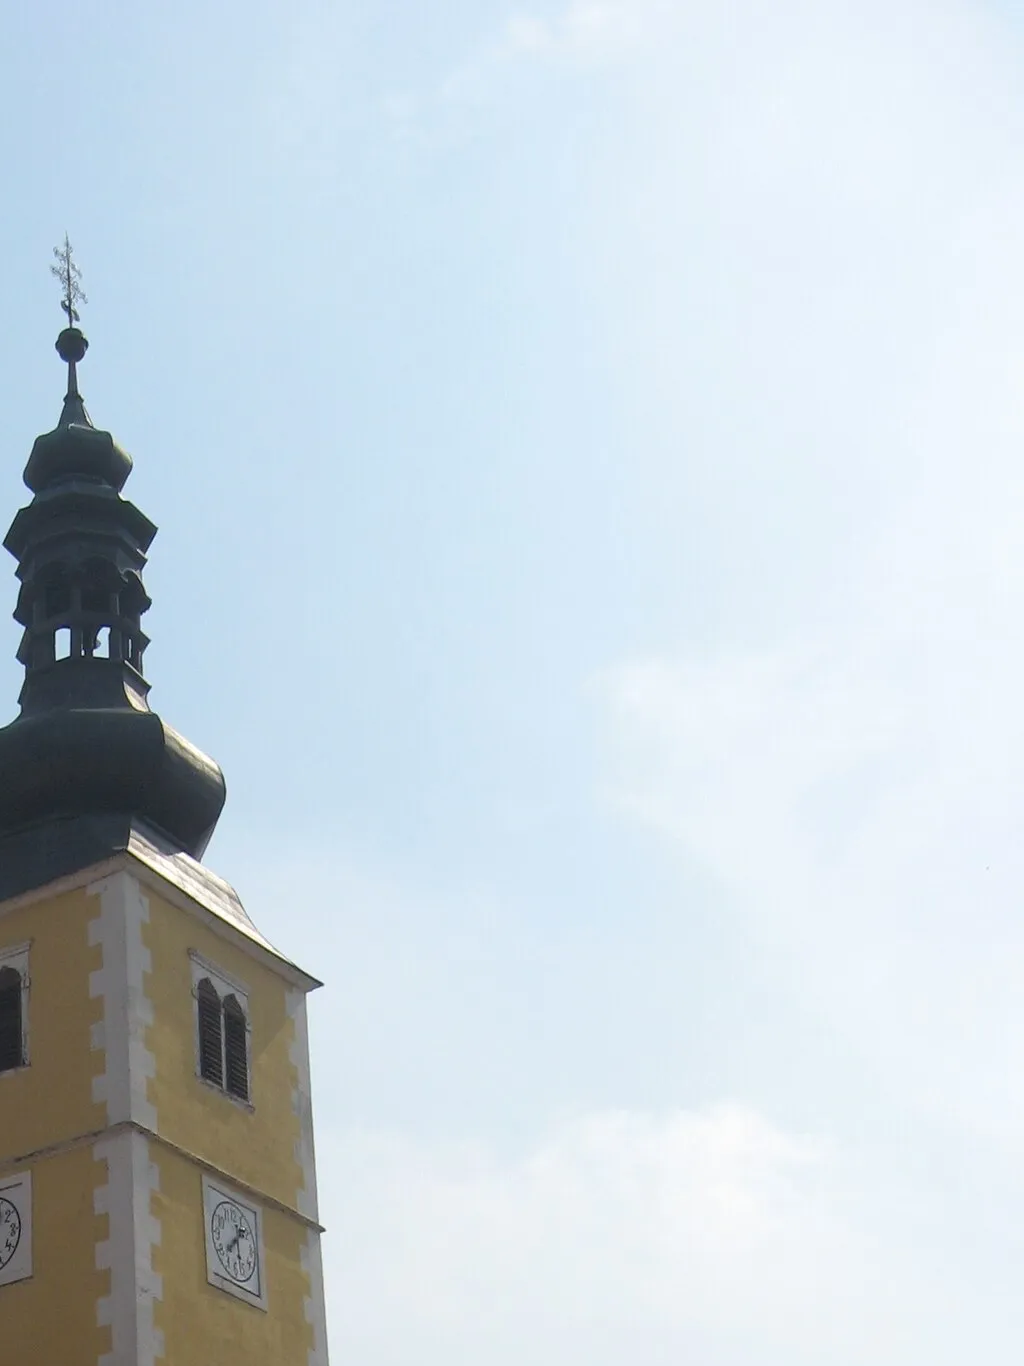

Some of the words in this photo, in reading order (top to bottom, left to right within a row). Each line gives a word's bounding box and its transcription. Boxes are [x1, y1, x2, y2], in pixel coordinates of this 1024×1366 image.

[5, 1209, 12, 1223] 2
[10, 1223, 16, 1237] 3
[5, 1238, 12, 1252] 4
